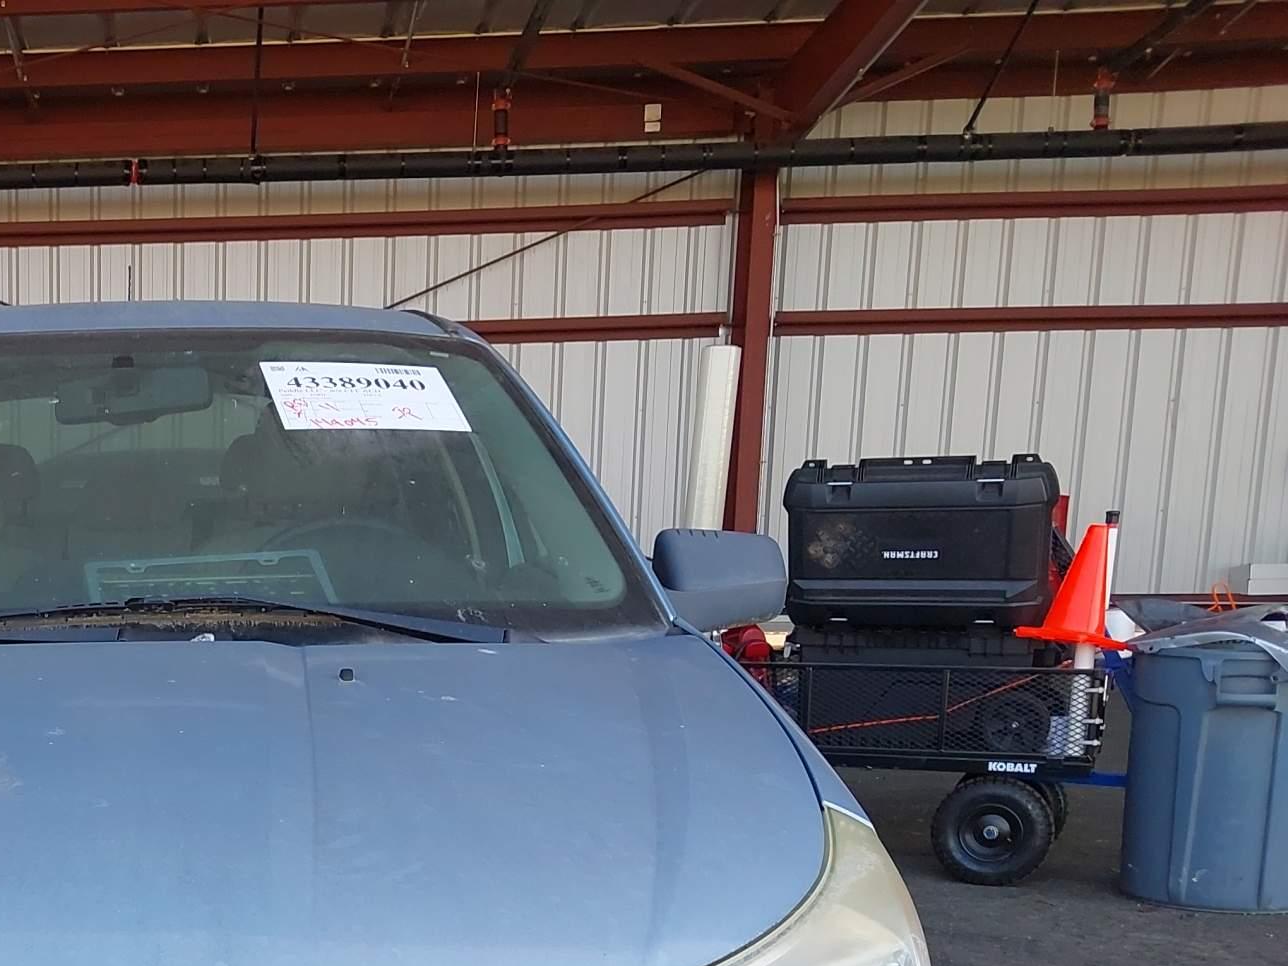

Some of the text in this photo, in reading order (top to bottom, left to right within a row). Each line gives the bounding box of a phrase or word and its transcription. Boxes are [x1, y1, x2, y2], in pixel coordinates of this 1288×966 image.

[287, 376, 427, 391] 43389040
[882, 550, 939, 559] CRAFTSMAN
[988, 761, 1038, 773] KOBALT
